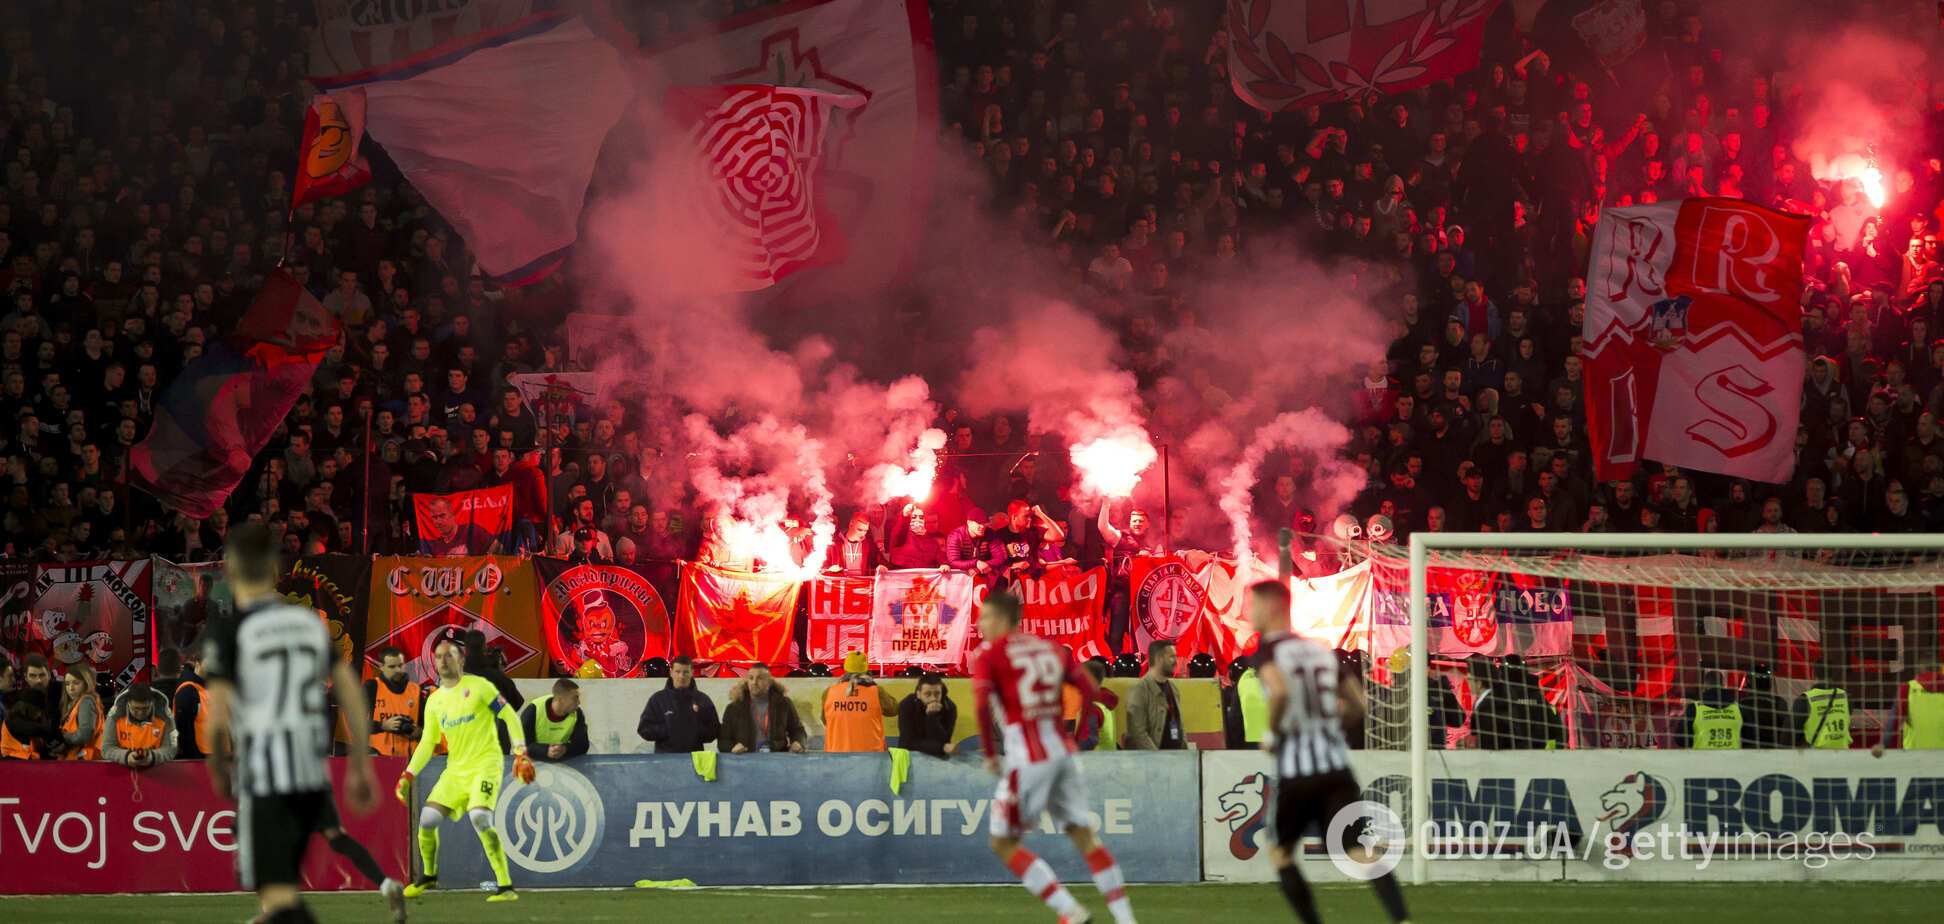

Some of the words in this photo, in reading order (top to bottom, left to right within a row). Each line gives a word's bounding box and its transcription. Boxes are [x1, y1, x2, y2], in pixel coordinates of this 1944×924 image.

[892, 640, 947, 653] ПРЕДАЈЕ
[902, 629, 938, 640] НЕМА
[1010, 653, 1063, 707] 29
[833, 701, 868, 712] PHOTO
[629, 800, 803, 848] ДУНАВ
[817, 799, 1134, 836] ОСИГУЕ
[1361, 774, 1584, 839] OMA
[132, 810, 240, 853] sve
